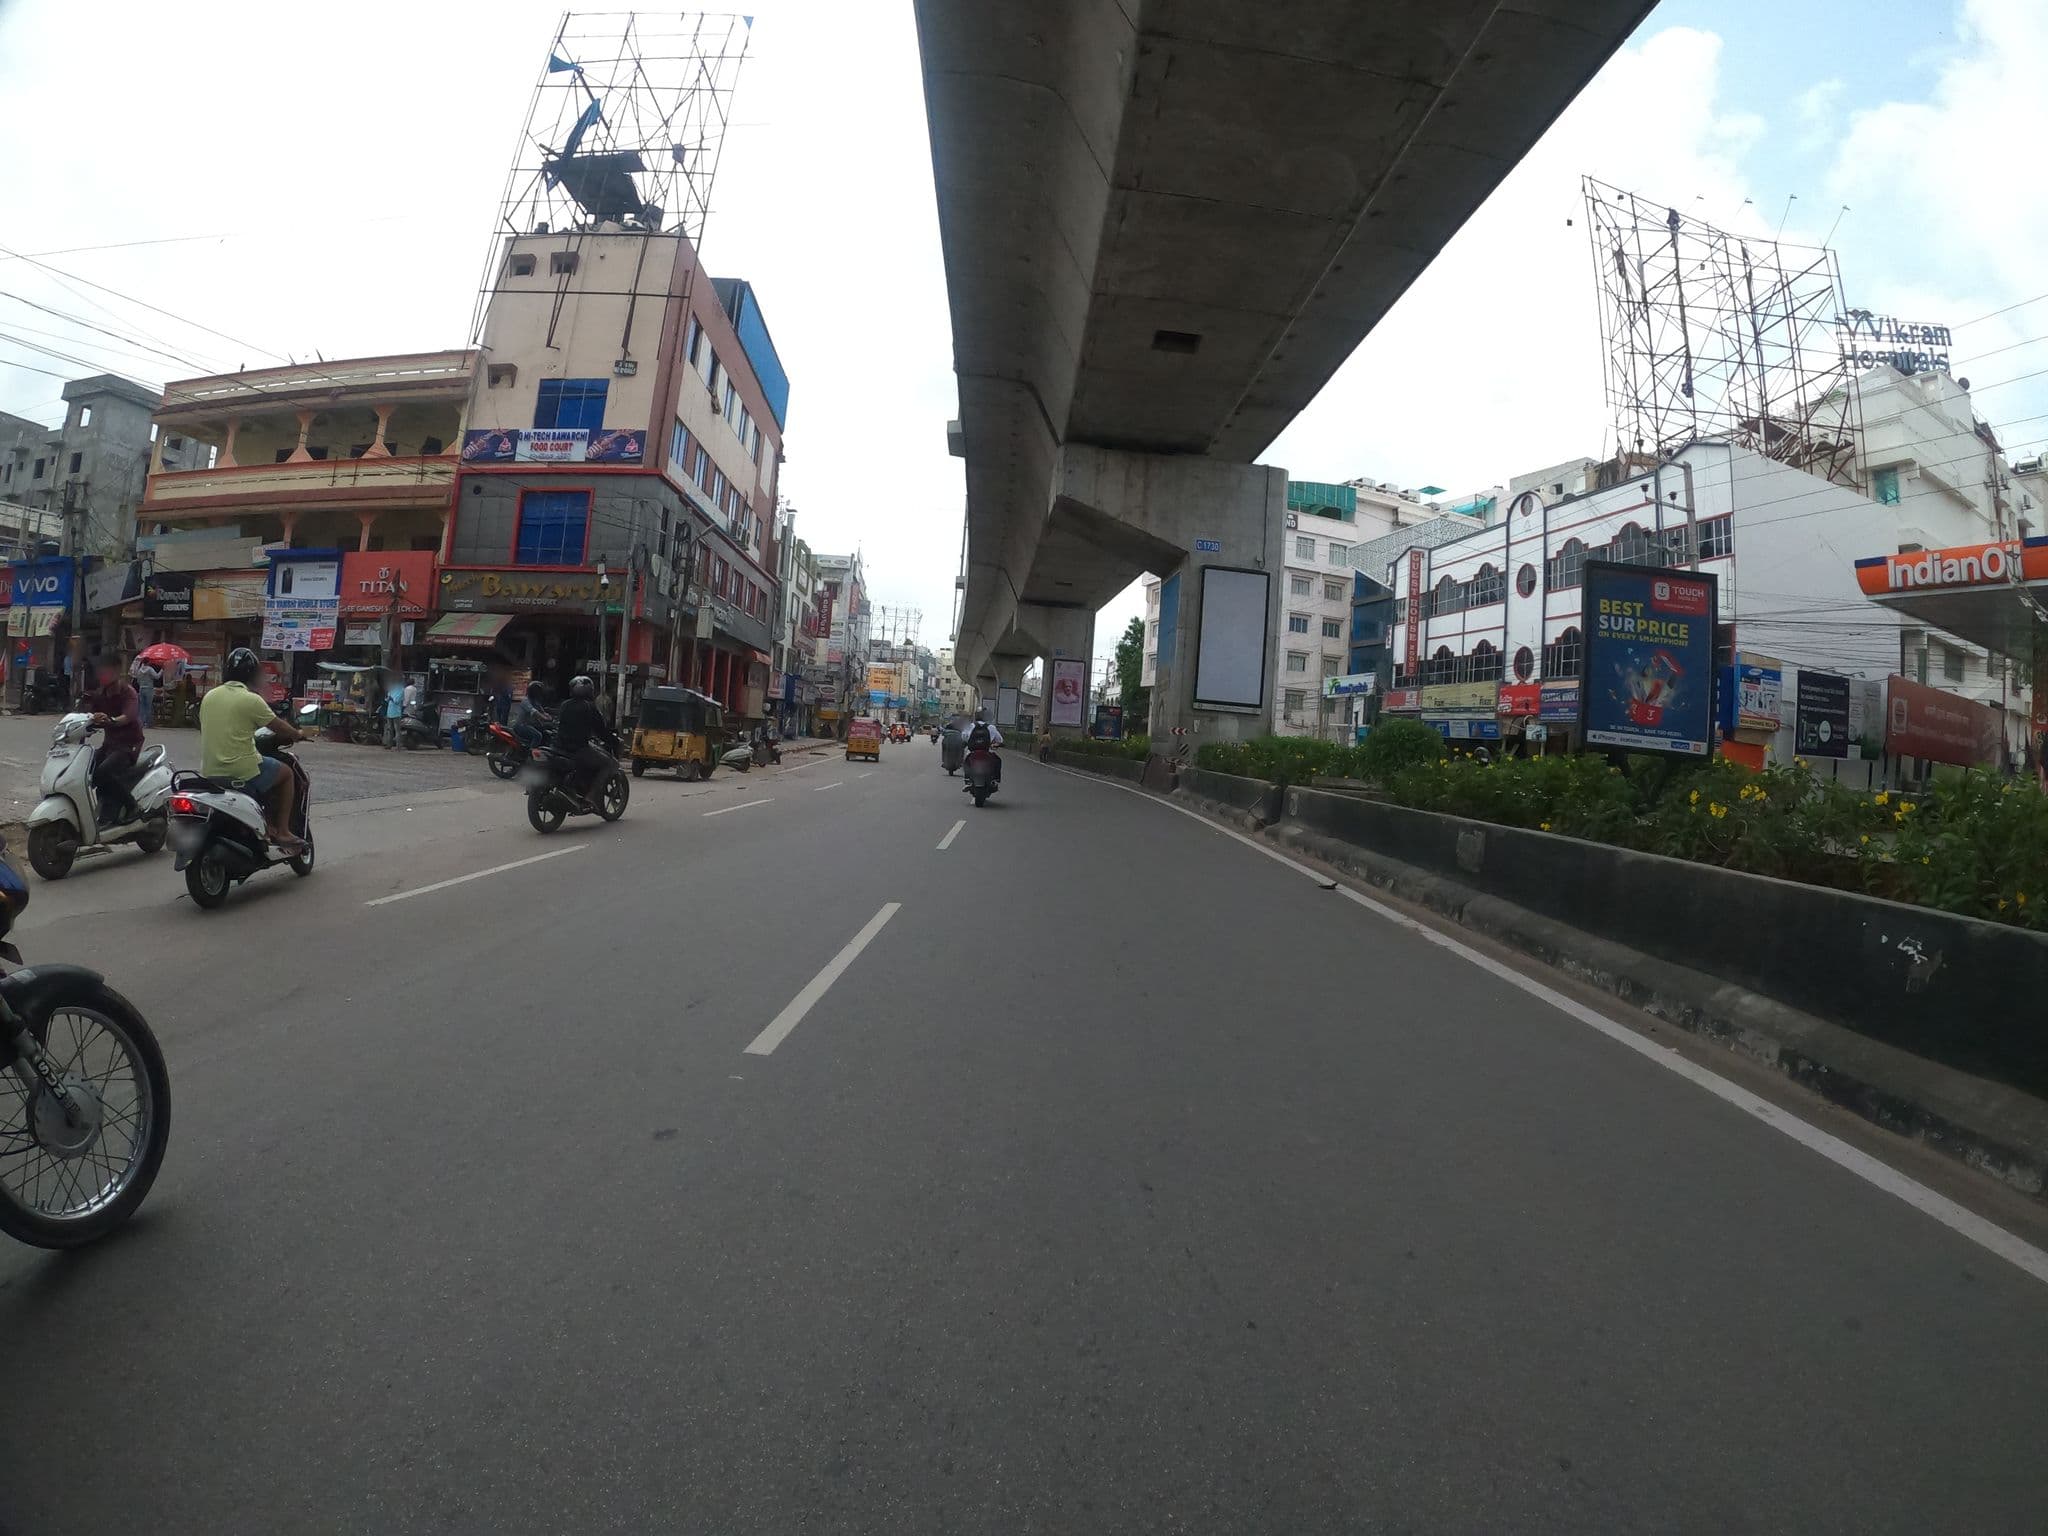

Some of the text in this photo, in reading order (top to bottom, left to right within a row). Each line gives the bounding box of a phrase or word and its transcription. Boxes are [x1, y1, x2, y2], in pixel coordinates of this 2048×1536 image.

[1863, 316, 1952, 346] Vikram
[549, 442, 574, 452] COURT
[1411, 553, 1420, 596] GUEST
[1888, 544, 2023, 589] IndianOil
[360, 581, 408, 593] TITAN
[1672, 586, 1705, 597] TOUCH
[1600, 599, 1644, 617] BEST
[1409, 599, 1419, 641] HOUSE
[1599, 615, 1689, 639] SURPRICE
[1613, 632, 1637, 641] EVERY
[610, 663, 639, 674] SOP
